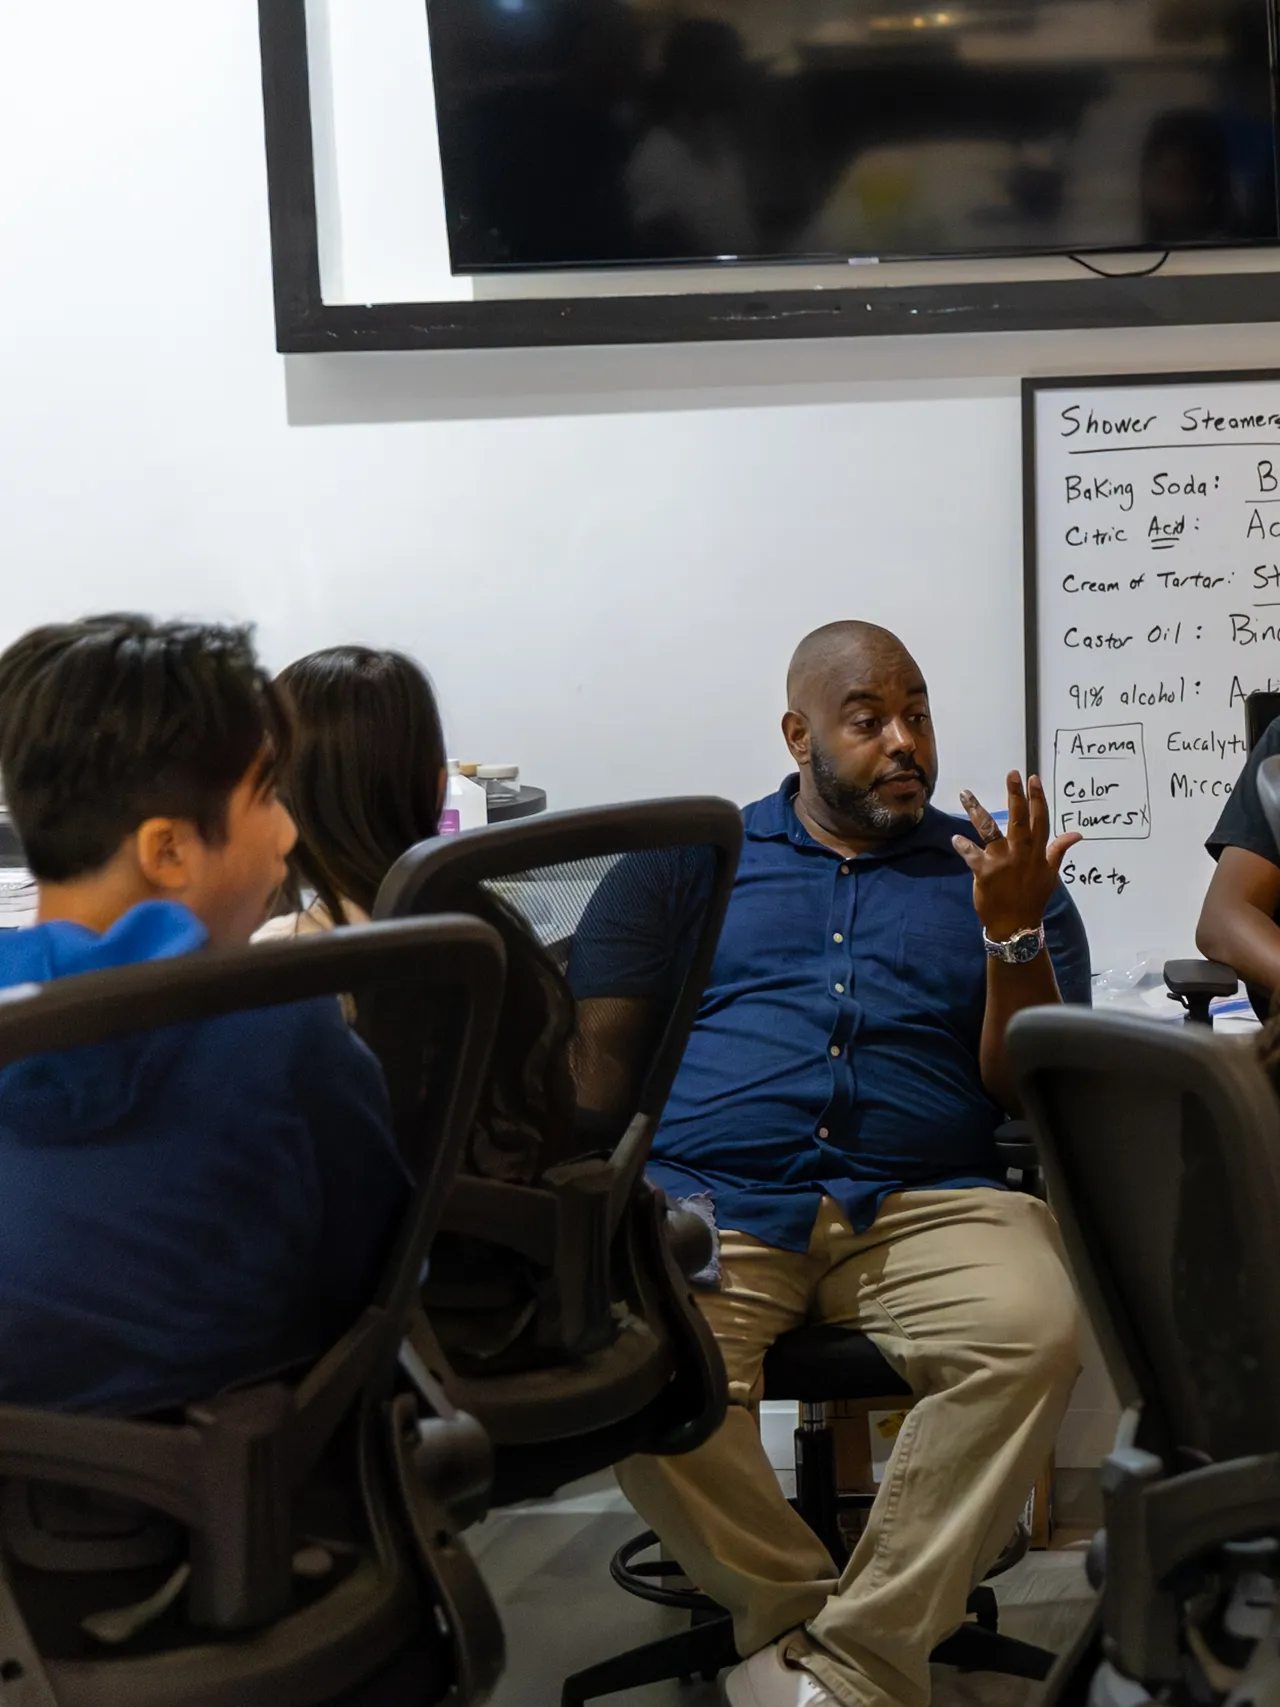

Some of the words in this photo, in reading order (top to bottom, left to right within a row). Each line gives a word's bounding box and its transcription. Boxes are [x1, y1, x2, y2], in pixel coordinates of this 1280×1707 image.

[1061, 405, 1157, 437] Shower
[1151, 472, 1220, 497] Soda:
[1065, 526, 1128, 546] Citric
[1062, 574, 1120, 593] Cream
[1129, 573, 1146, 590] of
[1157, 571, 1235, 589] Tartar:
[1064, 627, 1133, 649] Castor
[1069, 684, 1105, 709] 91%
[1070, 733, 1136, 756] Aroma
[1063, 777, 1119, 798] Color
[1061, 810, 1139, 833] Flowers
[1062, 860, 1130, 894] Safety
